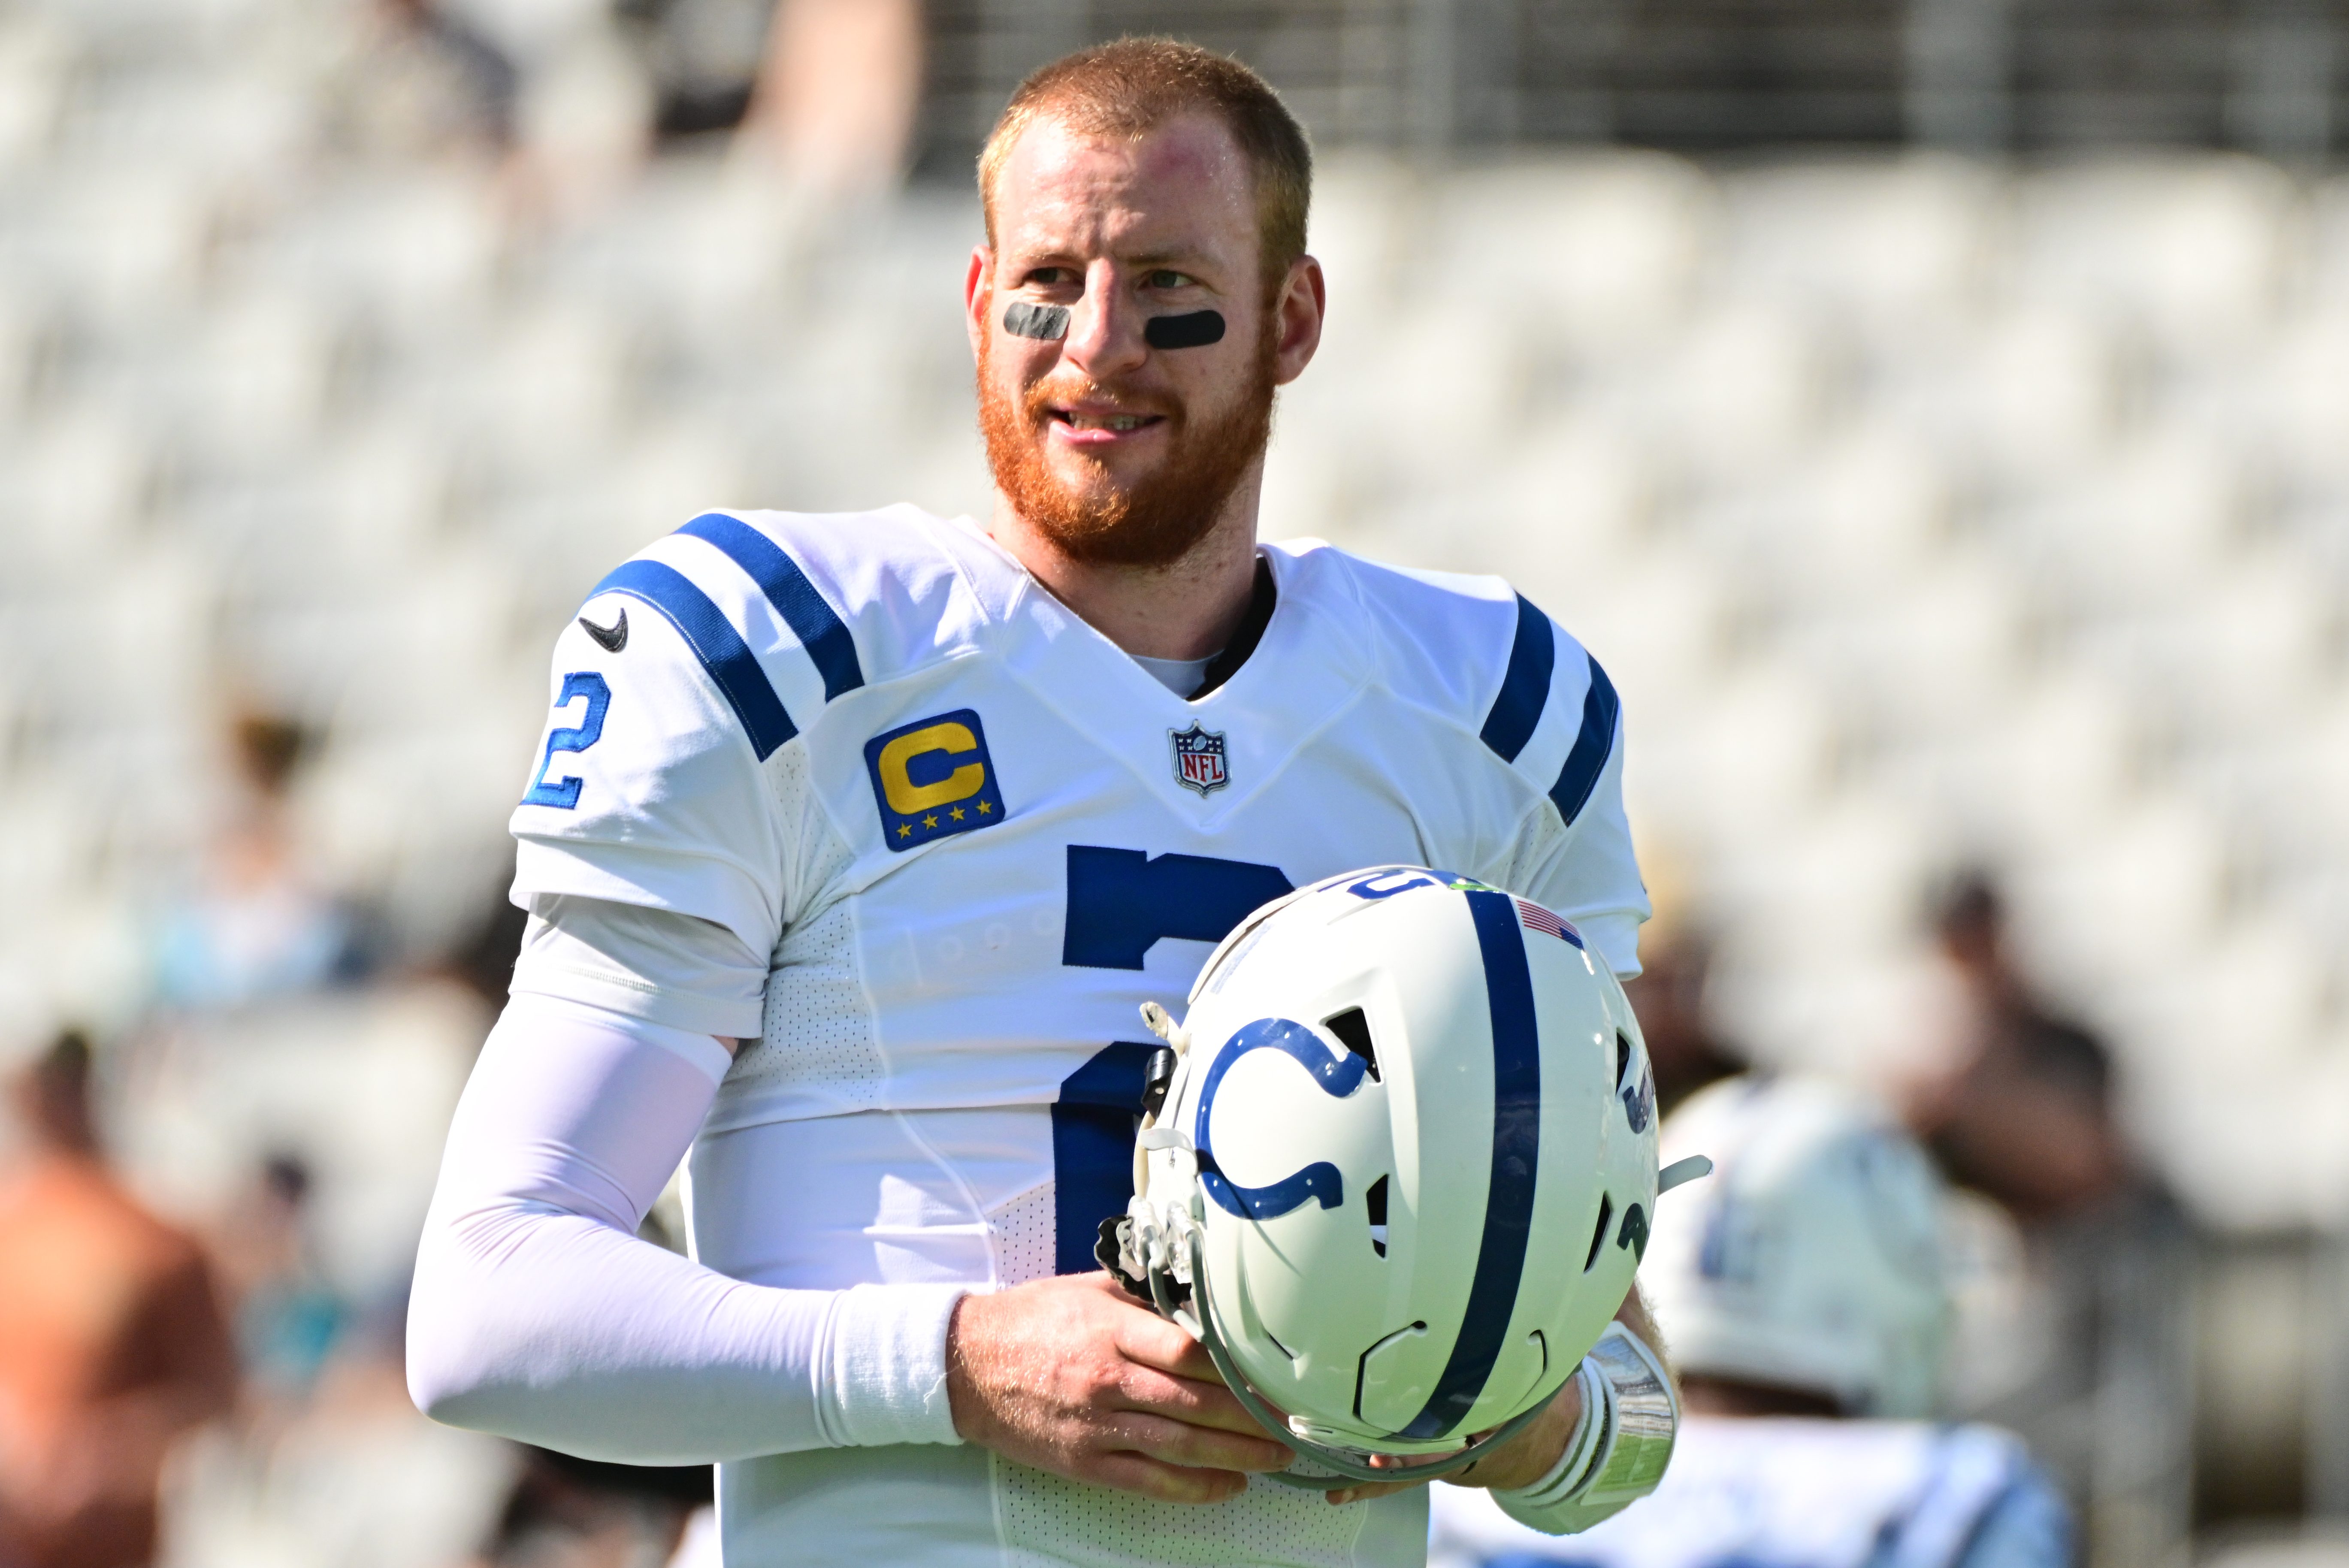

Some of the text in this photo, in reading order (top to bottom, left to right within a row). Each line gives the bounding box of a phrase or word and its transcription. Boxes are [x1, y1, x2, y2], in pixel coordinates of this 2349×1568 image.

[518, 671, 611, 810] 2
[878, 722, 985, 815] C
[1182, 754, 1223, 783] NFL
